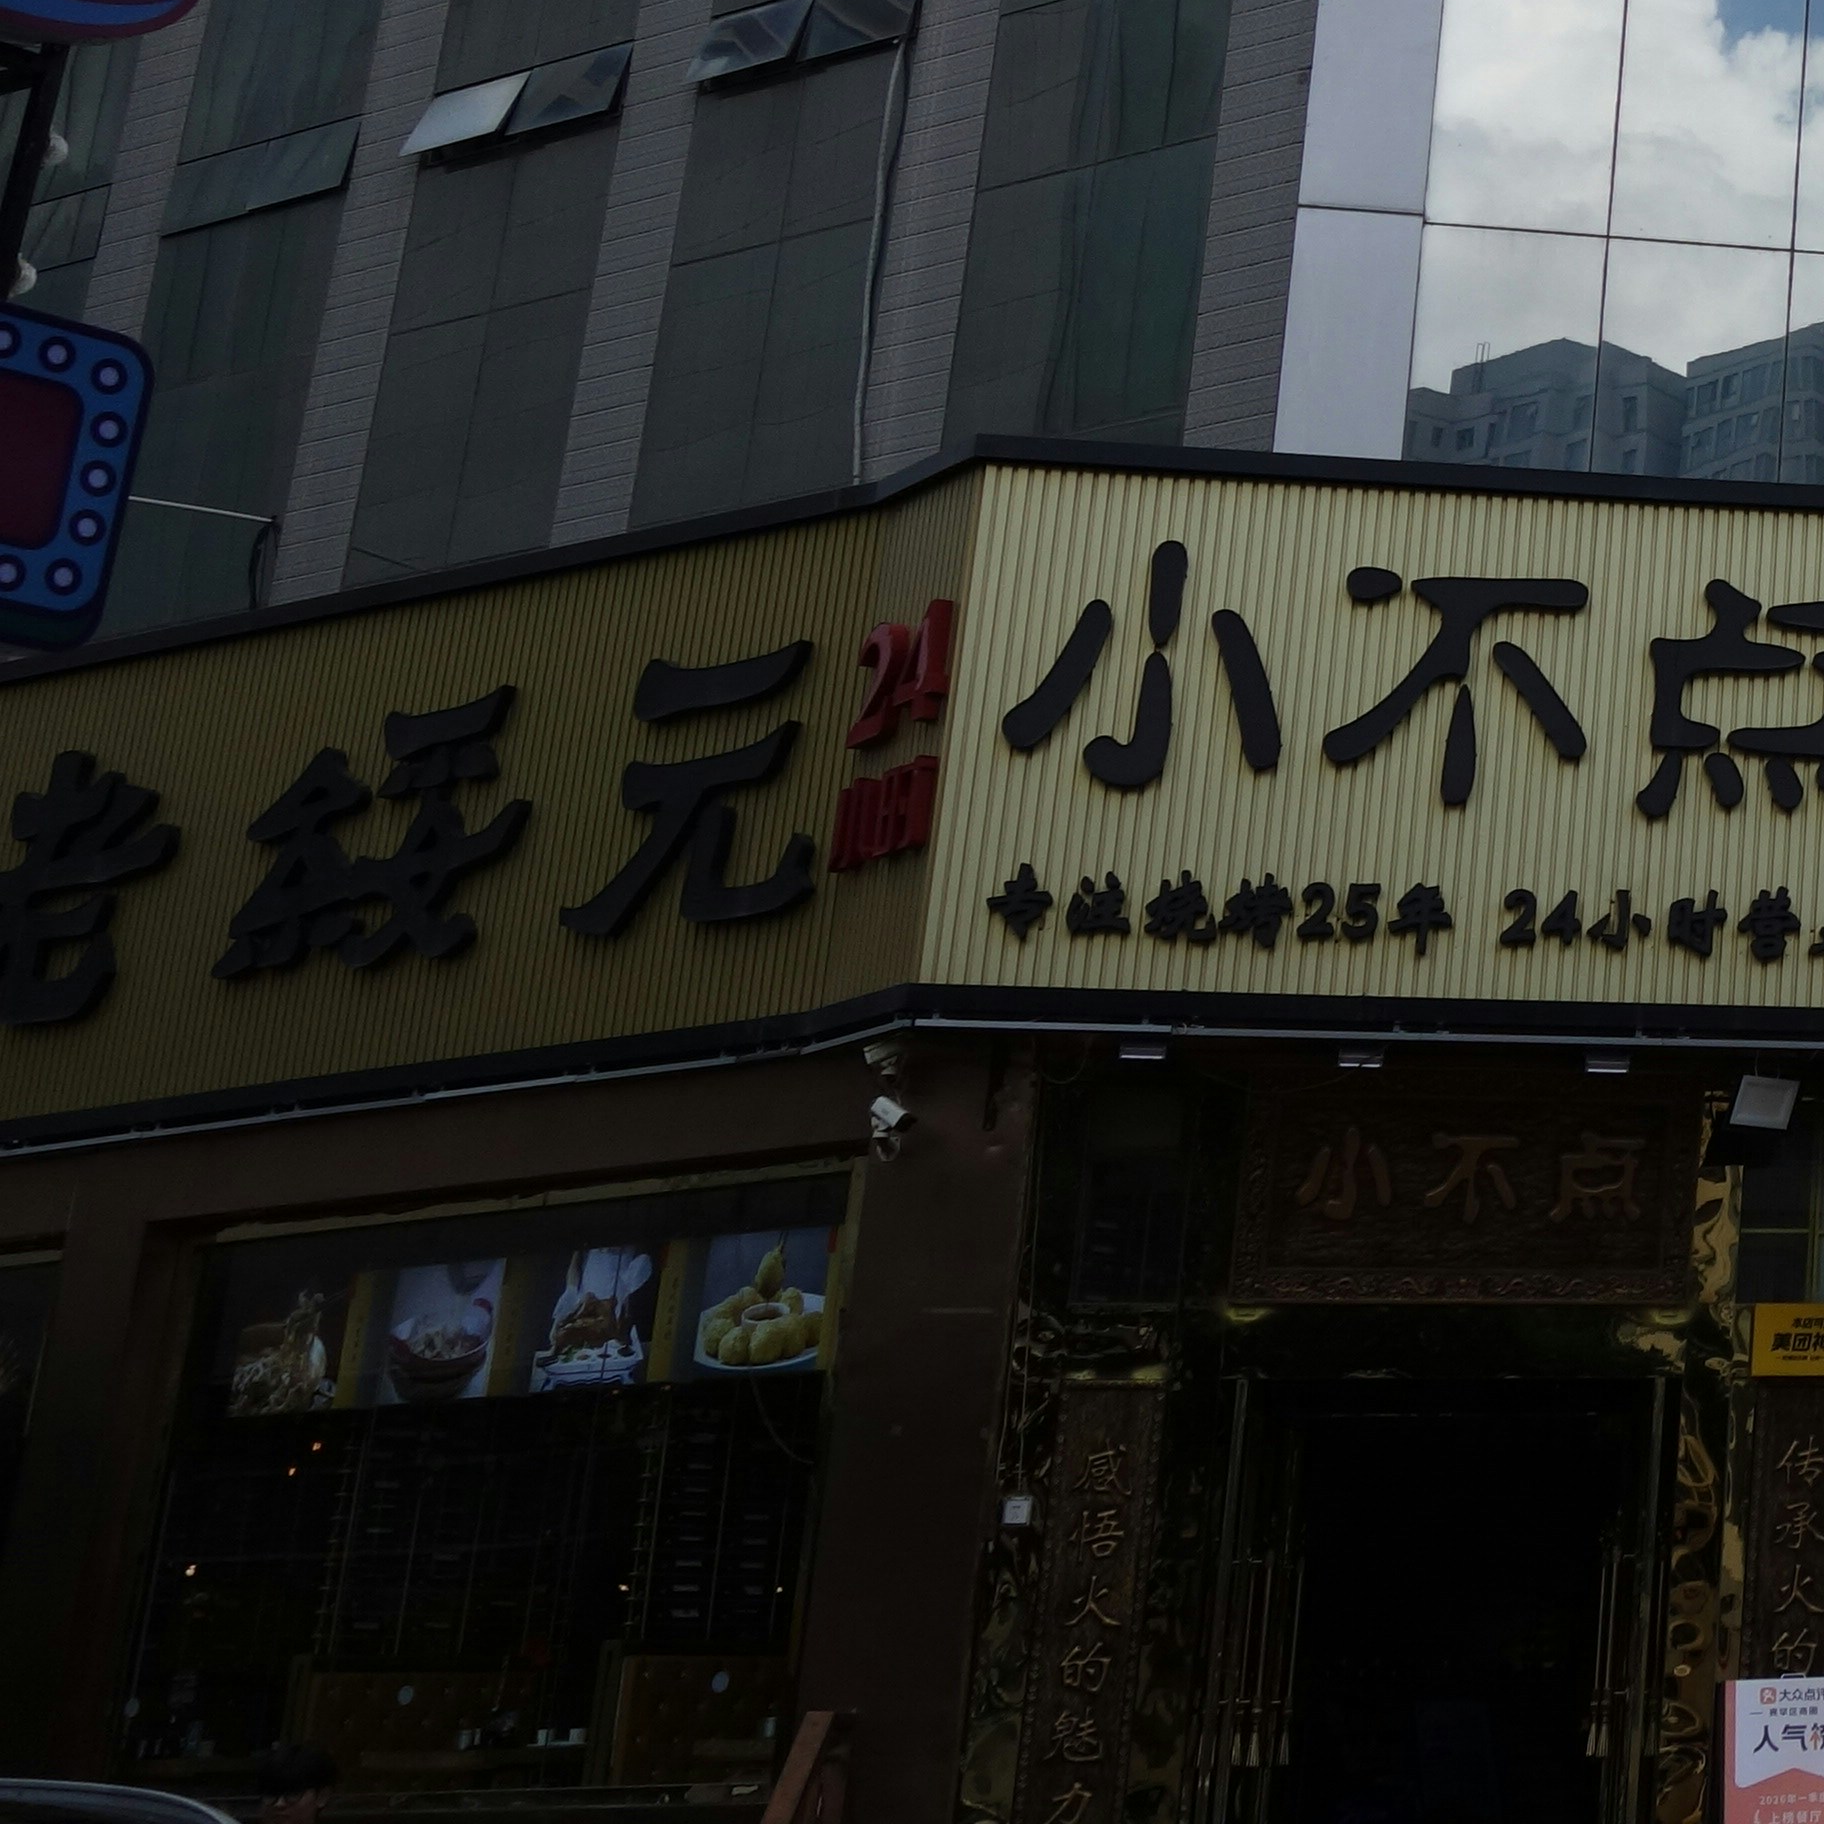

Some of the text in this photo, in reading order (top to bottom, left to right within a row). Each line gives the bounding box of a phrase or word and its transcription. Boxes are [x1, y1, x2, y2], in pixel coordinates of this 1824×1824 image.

[847, 599, 954, 749] 24
[986, 862, 1453, 955] 专注烧烤25年
[1294, 1126, 1647, 1224] 小不点
[1046, 1442, 1134, 1824] 感悟火的魅力
